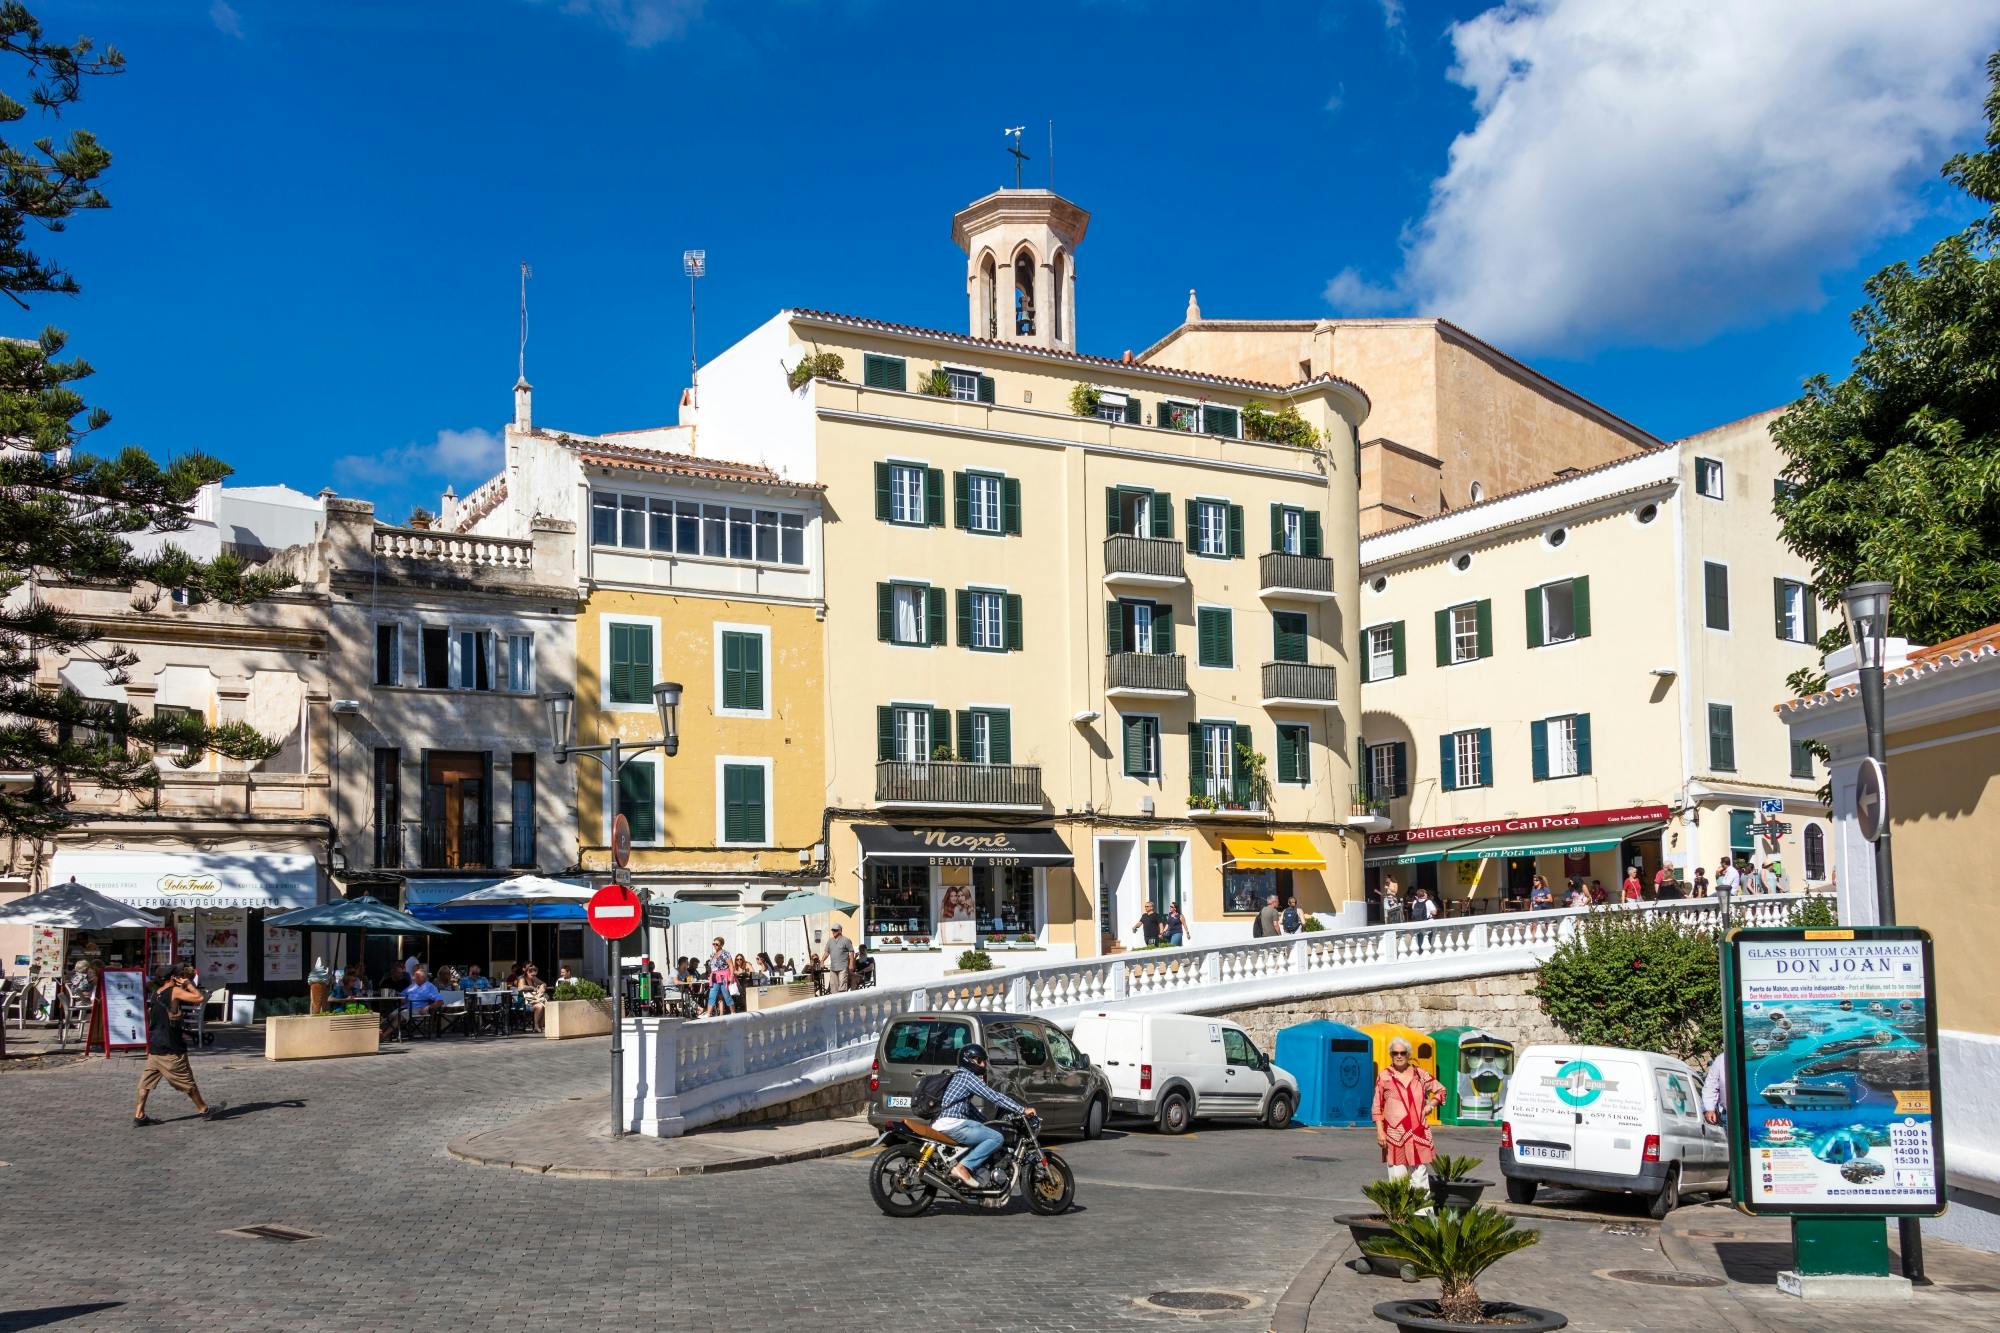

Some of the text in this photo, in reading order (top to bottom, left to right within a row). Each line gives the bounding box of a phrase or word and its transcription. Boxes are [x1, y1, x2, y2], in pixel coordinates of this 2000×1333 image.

[1406, 823, 1501, 841] Delicatessen
[1505, 820, 1538, 831] Can
[1541, 817, 1580, 828] Pota
[1477, 851, 1498, 859] Can
[1500, 849, 1525, 858] Pota
[929, 857, 1020, 866] BEAUTY SHOP
[146, 898, 186, 907] FROZEN
[189, 898, 229, 907] YOGURT
[232, 898, 239, 906] &
[242, 898, 279, 906] GELATO
[1748, 945, 1919, 958] GLASS BOTTOM CATAMARAN
[1776, 957, 1891, 973] DON JOAN
[1892, 1129, 1927, 1137] 11:00 h
[1893, 1138, 1928, 1146] 12:30 h
[1524, 1146, 1566, 1159] 6116 GJT
[1922, 1147, 1928, 1155] h
